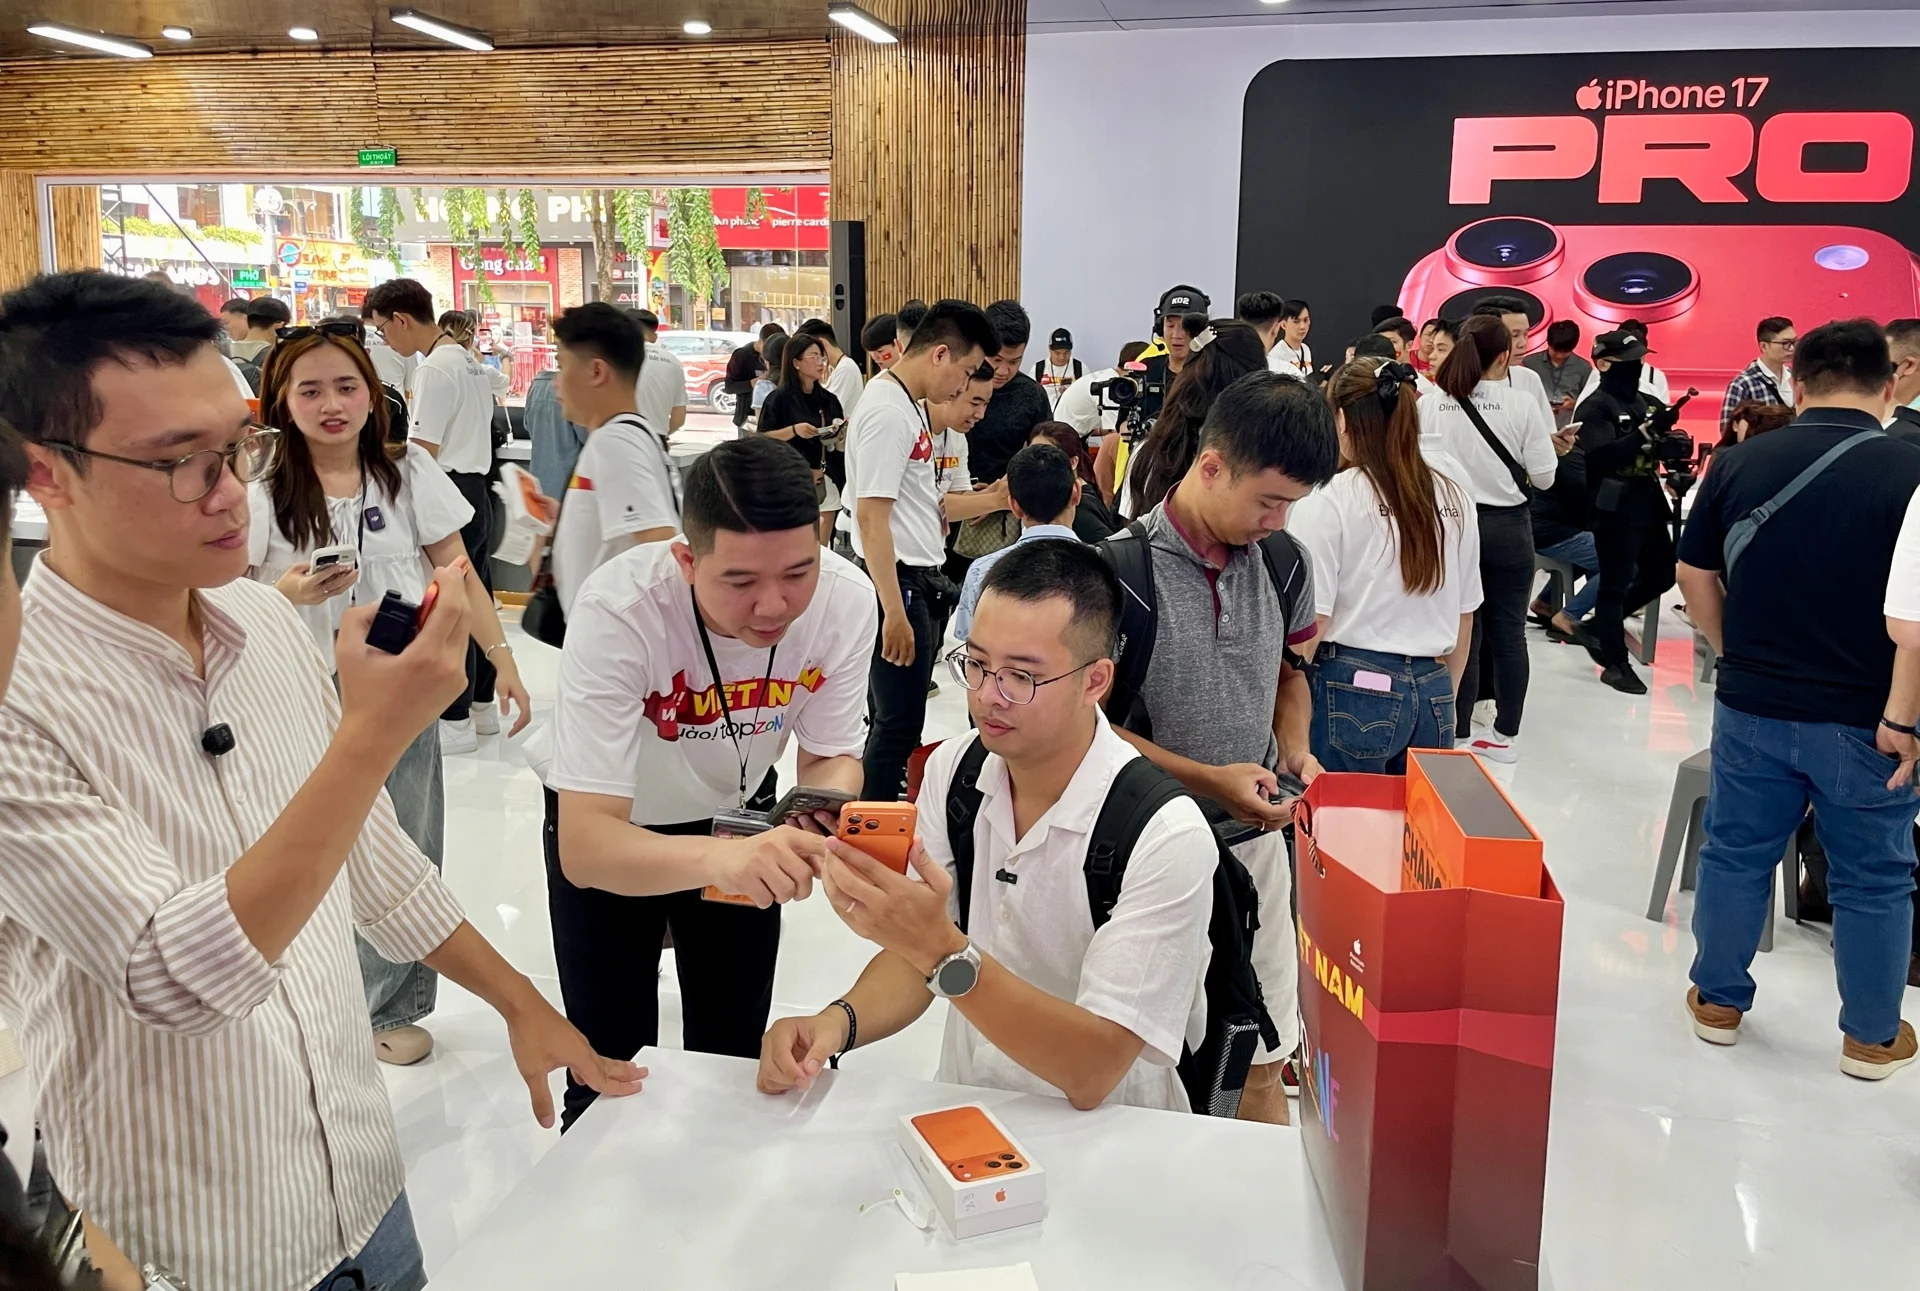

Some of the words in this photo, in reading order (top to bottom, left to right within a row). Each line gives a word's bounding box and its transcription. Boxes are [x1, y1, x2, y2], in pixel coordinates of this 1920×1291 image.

[1605, 79, 1726, 110] iPhone
[1731, 77, 1769, 108] 17
[1449, 111, 1914, 205] PRO
[772, 218, 802, 228] pierre
[1314, 947, 1364, 1021] NAM
